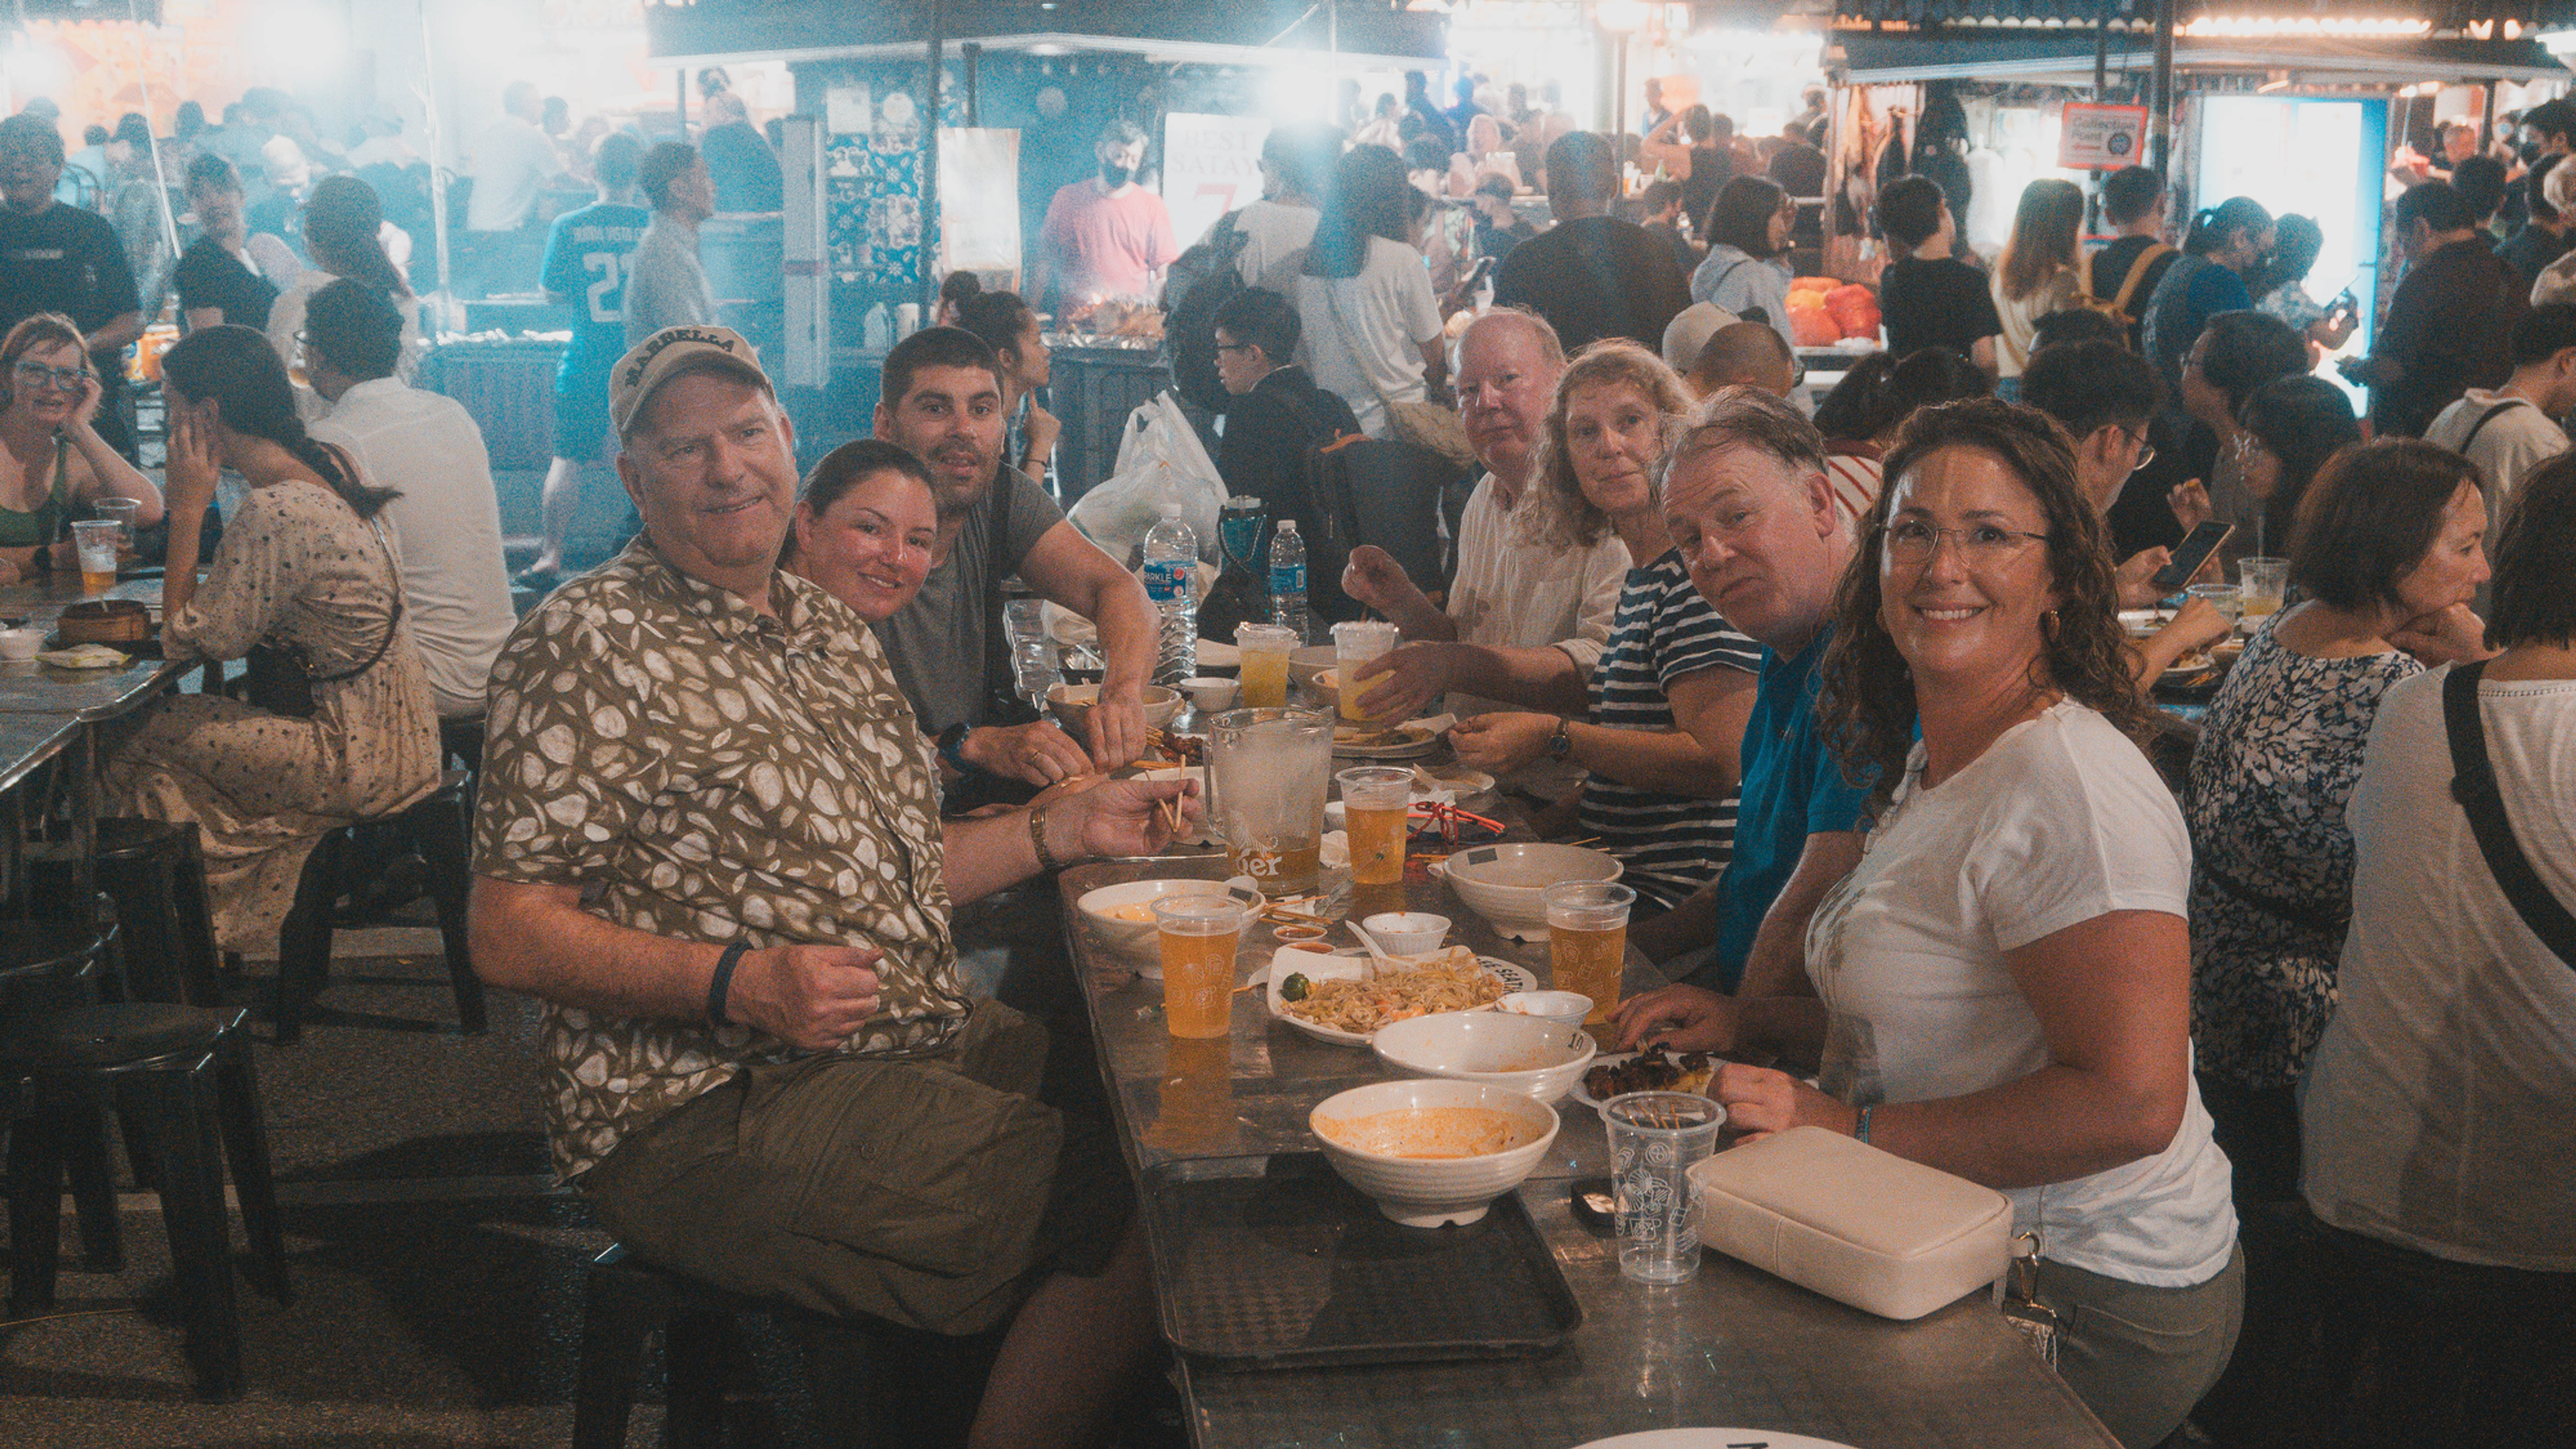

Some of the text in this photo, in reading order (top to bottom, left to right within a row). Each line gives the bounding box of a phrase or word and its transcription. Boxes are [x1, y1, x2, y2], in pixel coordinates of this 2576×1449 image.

[1183, 130, 1254, 150] BEST
[1170, 152, 1256, 177] SATAY
[625, 329, 735, 387] MARBELLA
